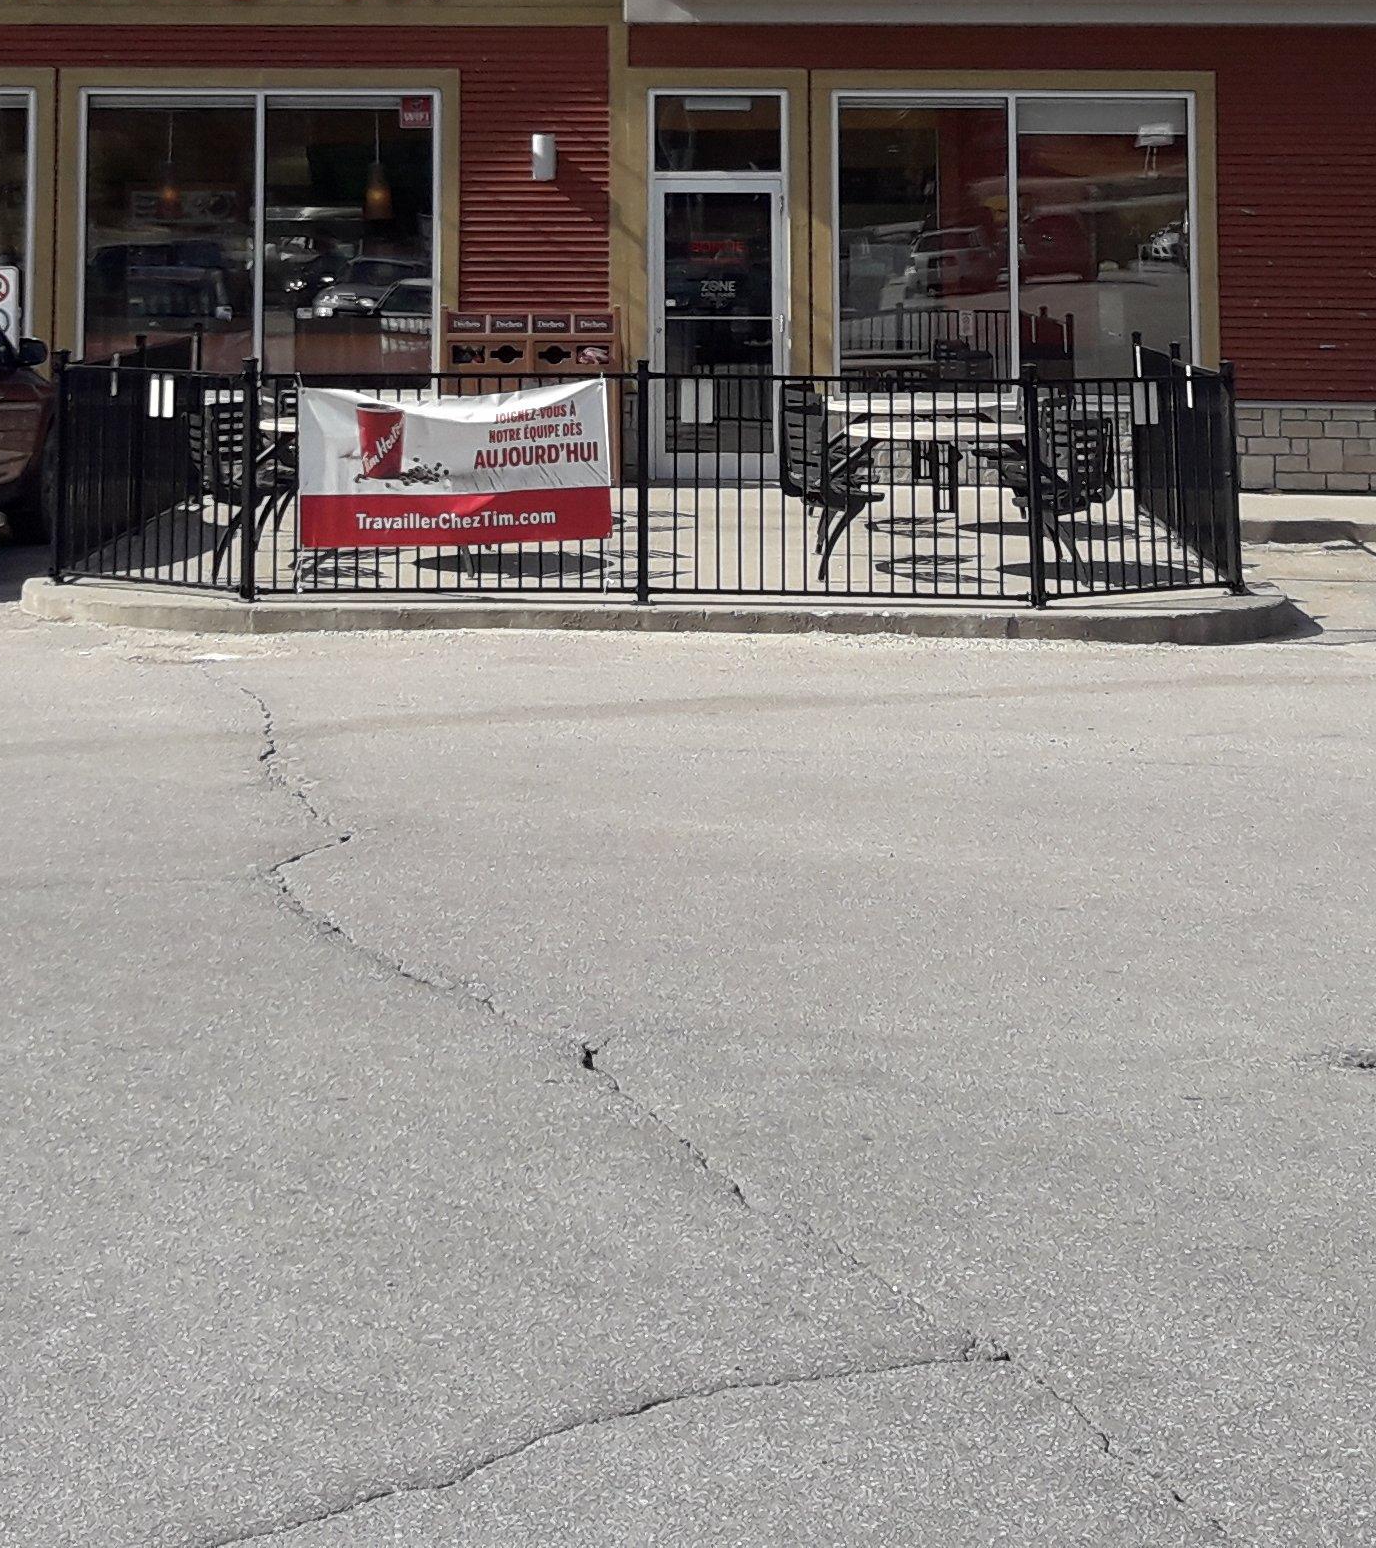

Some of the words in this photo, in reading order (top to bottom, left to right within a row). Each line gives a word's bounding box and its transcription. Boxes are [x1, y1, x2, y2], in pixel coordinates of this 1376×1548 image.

[700, 280, 736, 292] ZONE
[495, 404, 567, 424] JOIGNEZ-VOUS
[489, 428, 521, 443] NOTRE
[524, 424, 560, 442] ÉQUIPE
[563, 419, 582, 437] DÈS
[474, 442, 598, 470] AUJOURD'HUI
[355, 510, 556, 530] TravaillerChezTim.com
